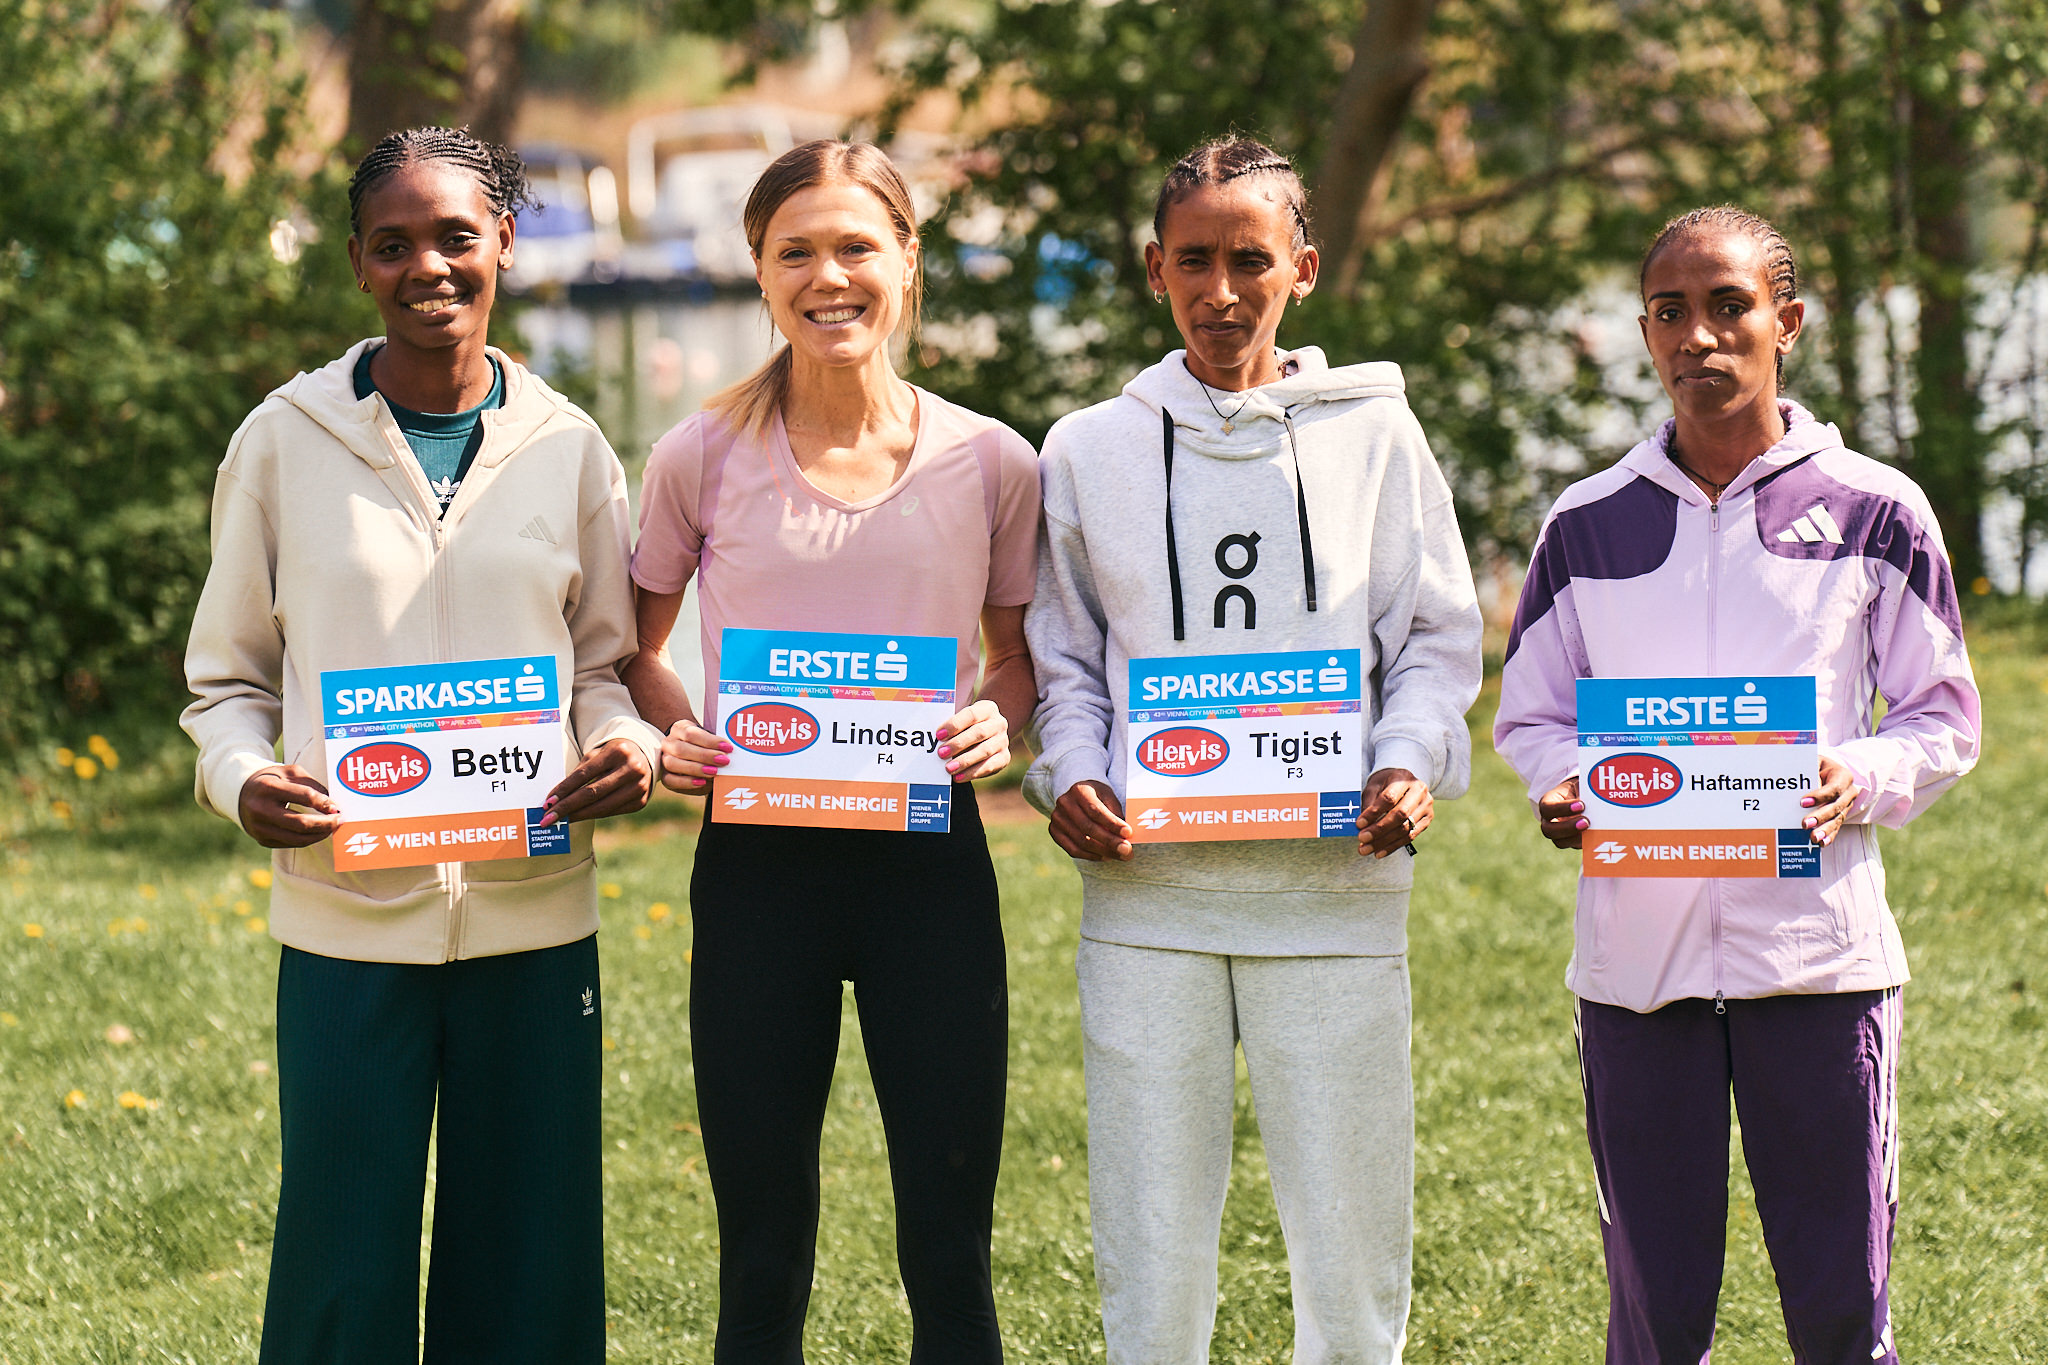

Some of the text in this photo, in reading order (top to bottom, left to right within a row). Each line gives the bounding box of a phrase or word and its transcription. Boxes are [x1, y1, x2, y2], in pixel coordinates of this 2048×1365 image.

[769, 649, 870, 680] ERSTE
[1142, 669, 1313, 701] SPARKASSE
[336, 678, 512, 715] SPARKASSE
[1203, 708, 1236, 716] MARATHON
[1626, 697, 1728, 726] ERSTE
[363, 724, 386, 733] VIENNA
[386, 723, 400, 731] CITY
[400, 721, 434, 730] MARATHON
[736, 713, 812, 745] Hervis
[745, 738, 775, 747] SPORTS
[832, 722, 939, 753] Lindsay
[1250, 731, 1341, 763] Tigist
[452, 745, 543, 779] Betty
[877, 753, 894, 764] F4
[1147, 740, 1222, 765] Hervis
[346, 755, 424, 784] Hervis
[1287, 768, 1303, 779] F3
[358, 780, 388, 790] SPORTS
[492, 781, 506, 792] F1
[1598, 765, 1675, 796] Hervis
[1691, 774, 1811, 791] Haftamnesh
[766, 793, 898, 812] WIEN ENERGIE
[1743, 800, 1760, 810] F2
[1178, 808, 1310, 825] WIEN ENERGIE
[385, 825, 518, 848] WIEN ENERGIE
[531, 834, 565, 842] STADTWERKE
[1634, 845, 1768, 860] WIEN ENERGIE
